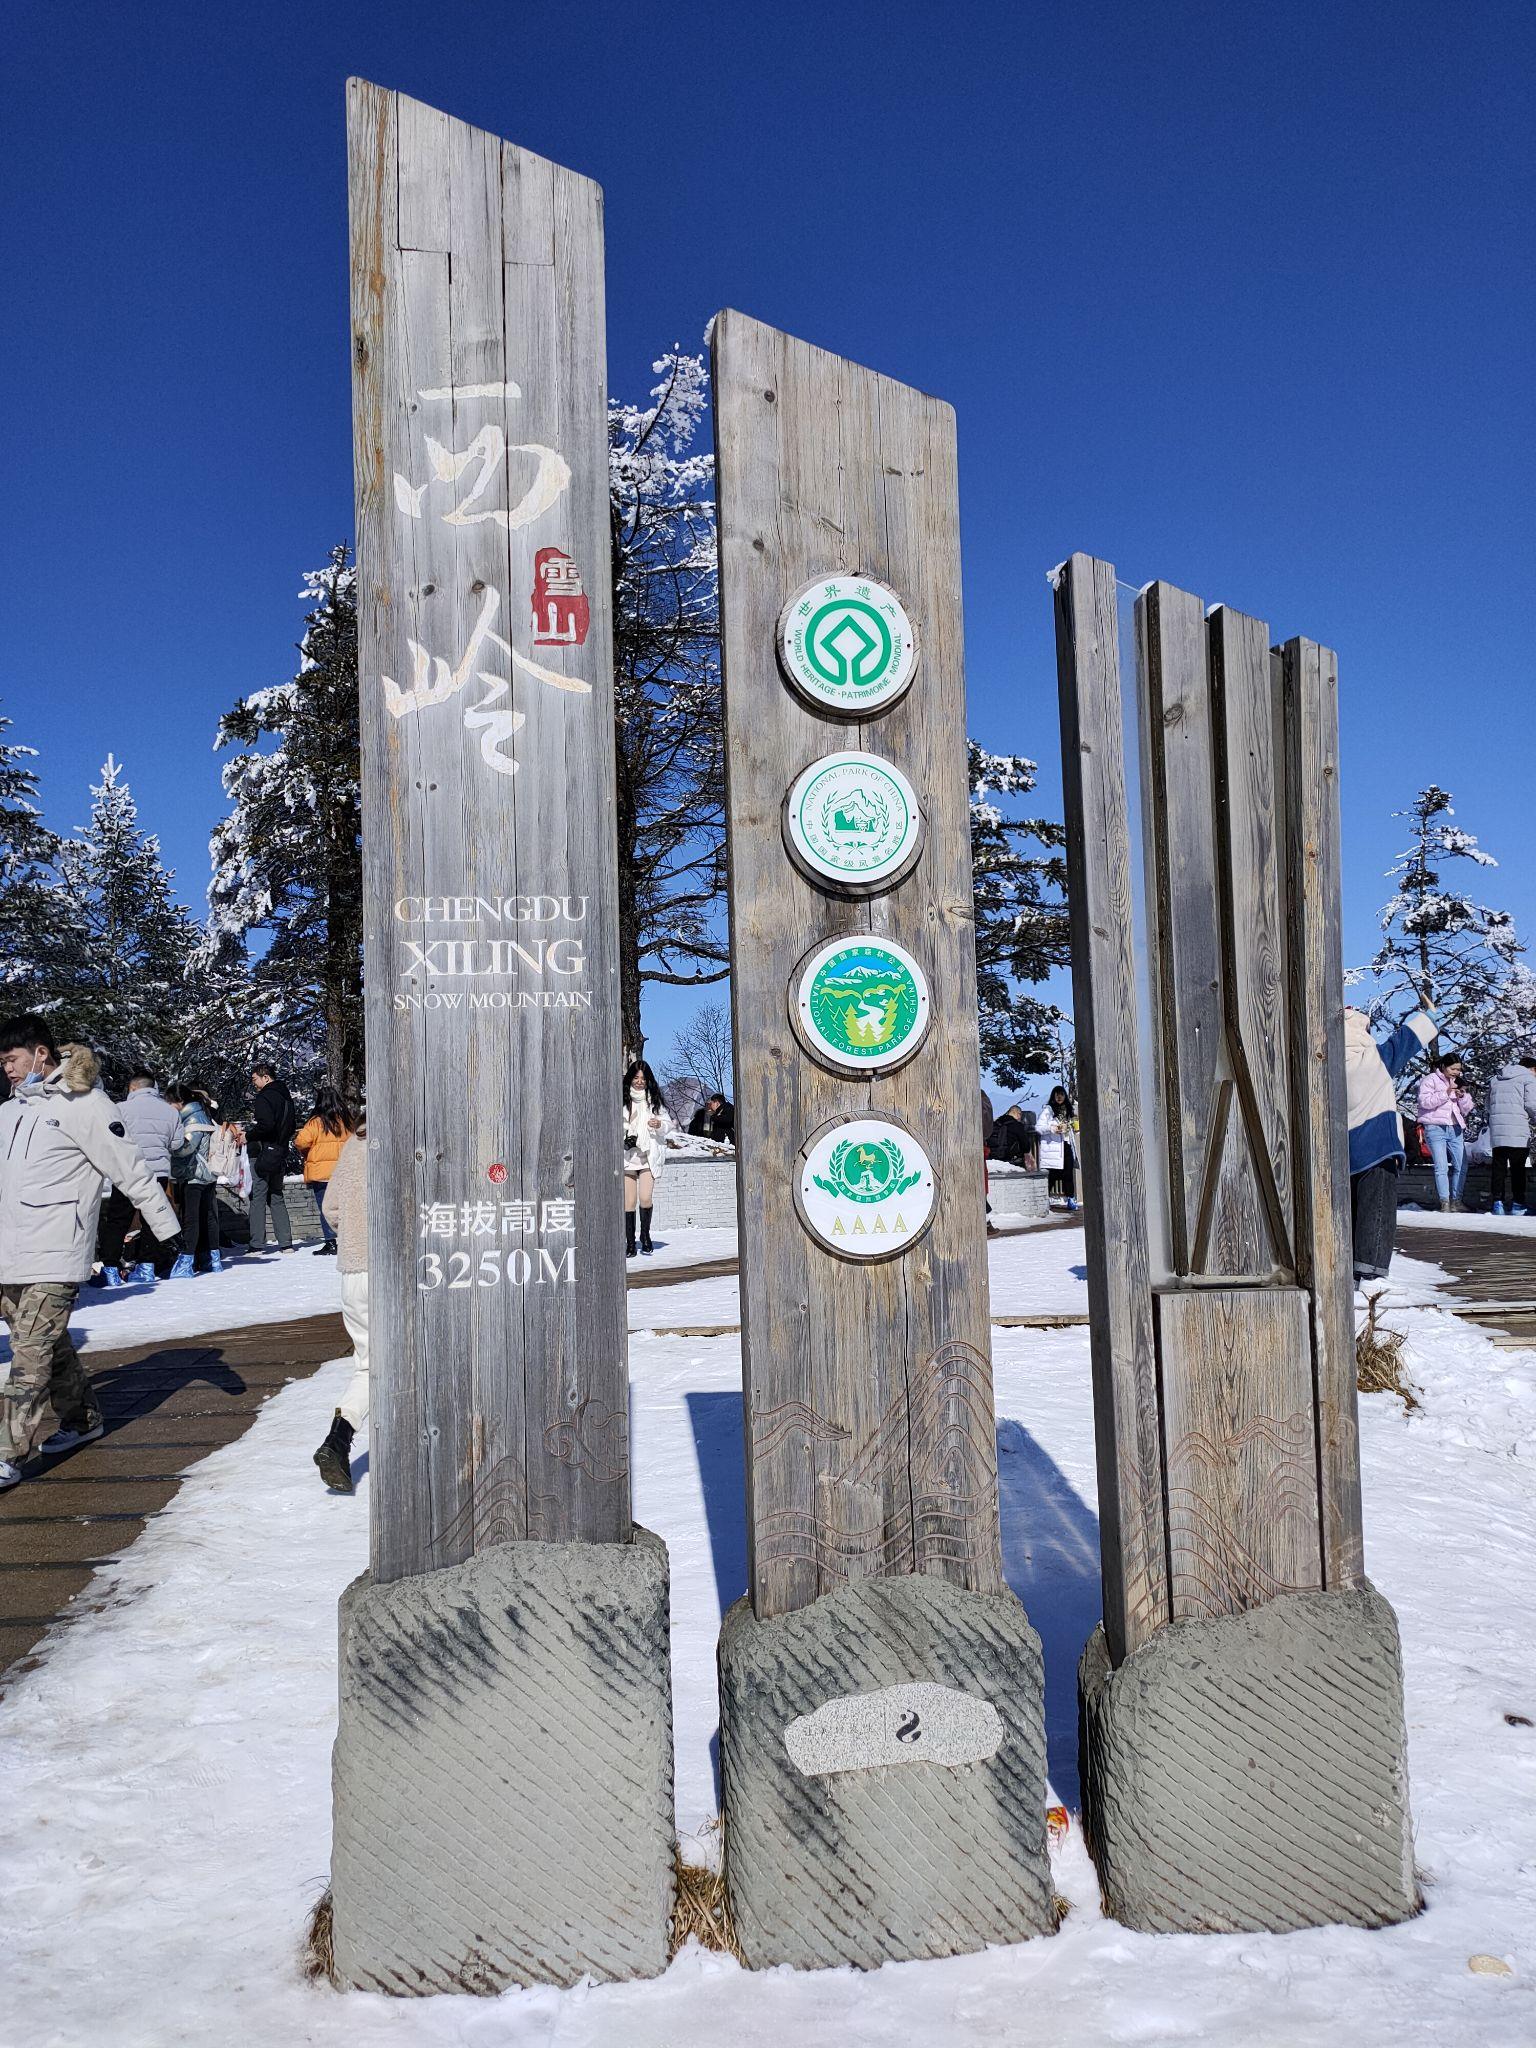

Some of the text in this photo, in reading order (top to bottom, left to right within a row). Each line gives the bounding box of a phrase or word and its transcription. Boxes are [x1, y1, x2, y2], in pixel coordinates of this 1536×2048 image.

[798, 584, 897, 618] 世界遗产
[794, 629, 902, 699] WORLD HERITAGE PATRIMOINE MONDIAL
[806, 768, 903, 812] NATIONAL PARK OF CHINA
[394, 896, 590, 923] CHENGDU
[399, 938, 587, 977] XILING
[393, 990, 593, 1010] SNOW MOUNTAIN
[812, 978, 917, 1055] NATIONAL FOREST PARK OF CHINA
[419, 1197, 577, 1238] 海拔高度
[418, 1246, 580, 1290] 3250M
